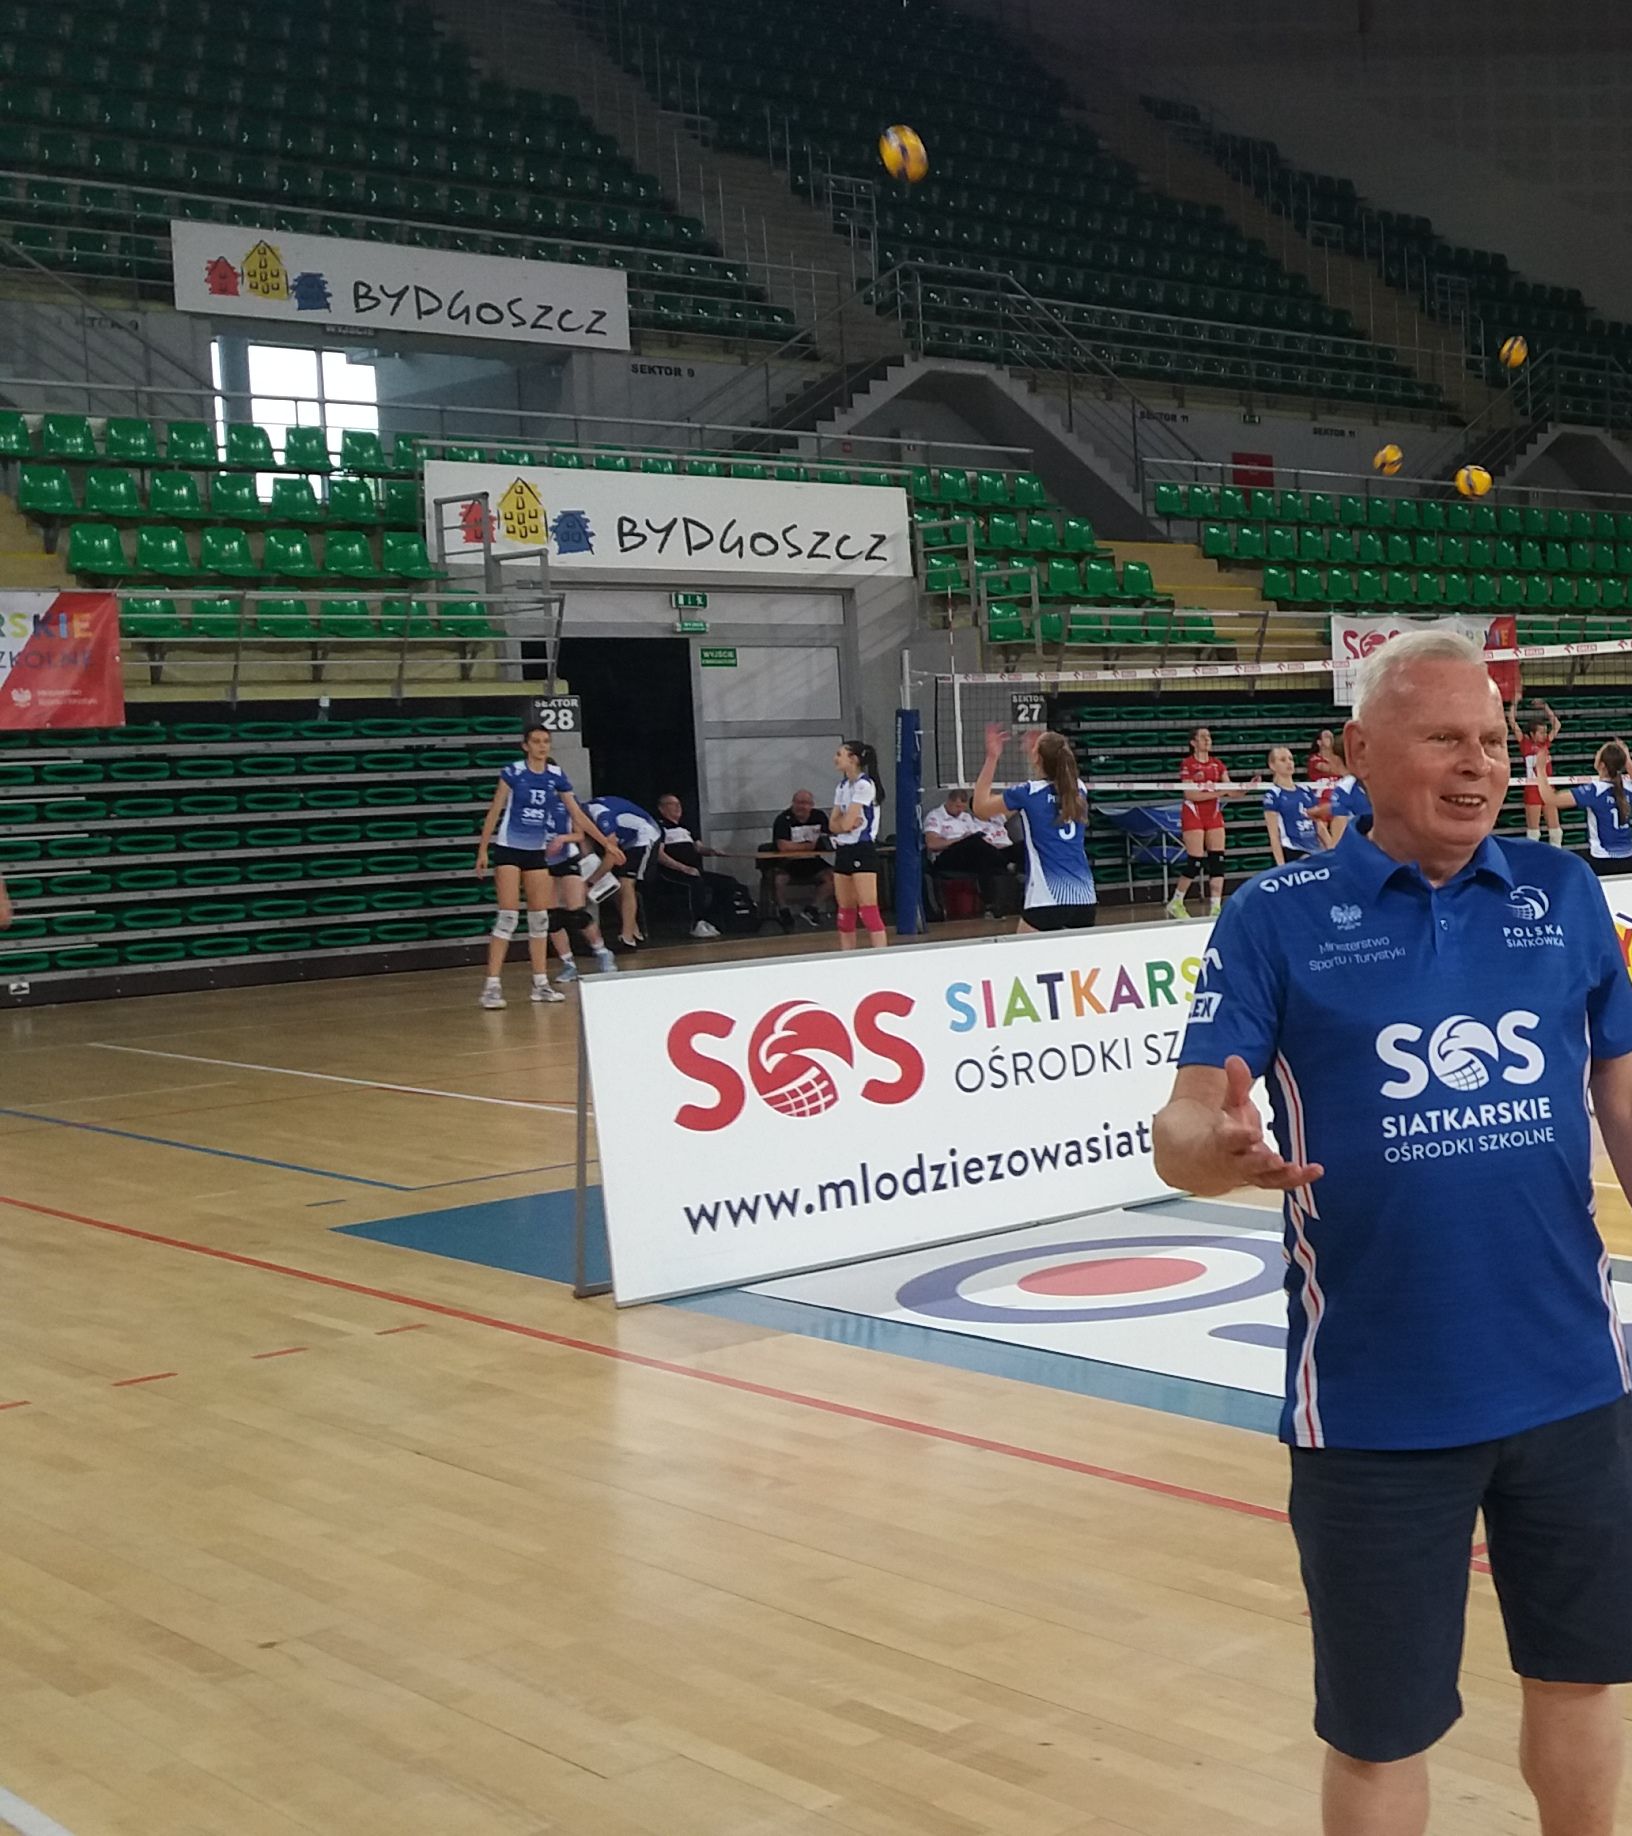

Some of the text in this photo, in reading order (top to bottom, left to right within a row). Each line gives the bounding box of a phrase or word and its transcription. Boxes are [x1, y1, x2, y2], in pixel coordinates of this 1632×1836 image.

[353, 280, 608, 336] BYDGOSZCZ
[631, 363, 682, 377] SEKTOR
[617, 515, 890, 563] BYDGOSZCZ
[540, 709, 575, 732] 28
[1017, 703, 1042, 722] 27
[529, 789, 546, 806] 13
[1503, 923, 1564, 938] POLSKA
[1505, 936, 1566, 949] SIATKÓWKA
[1318, 935, 1390, 955] Ministerstwo
[1308, 954, 1347, 972] Sportu
[1352, 946, 1407, 966] Turystyki
[665, 989, 926, 1133] SOS
[954, 1030, 1133, 1095] OŚRODKI
[1375, 1009, 1546, 1100] SOS
[1381, 1096, 1553, 1140] SIATKARSKIE
[1384, 1126, 1556, 1164] OŚRODKI SZKOLNE
